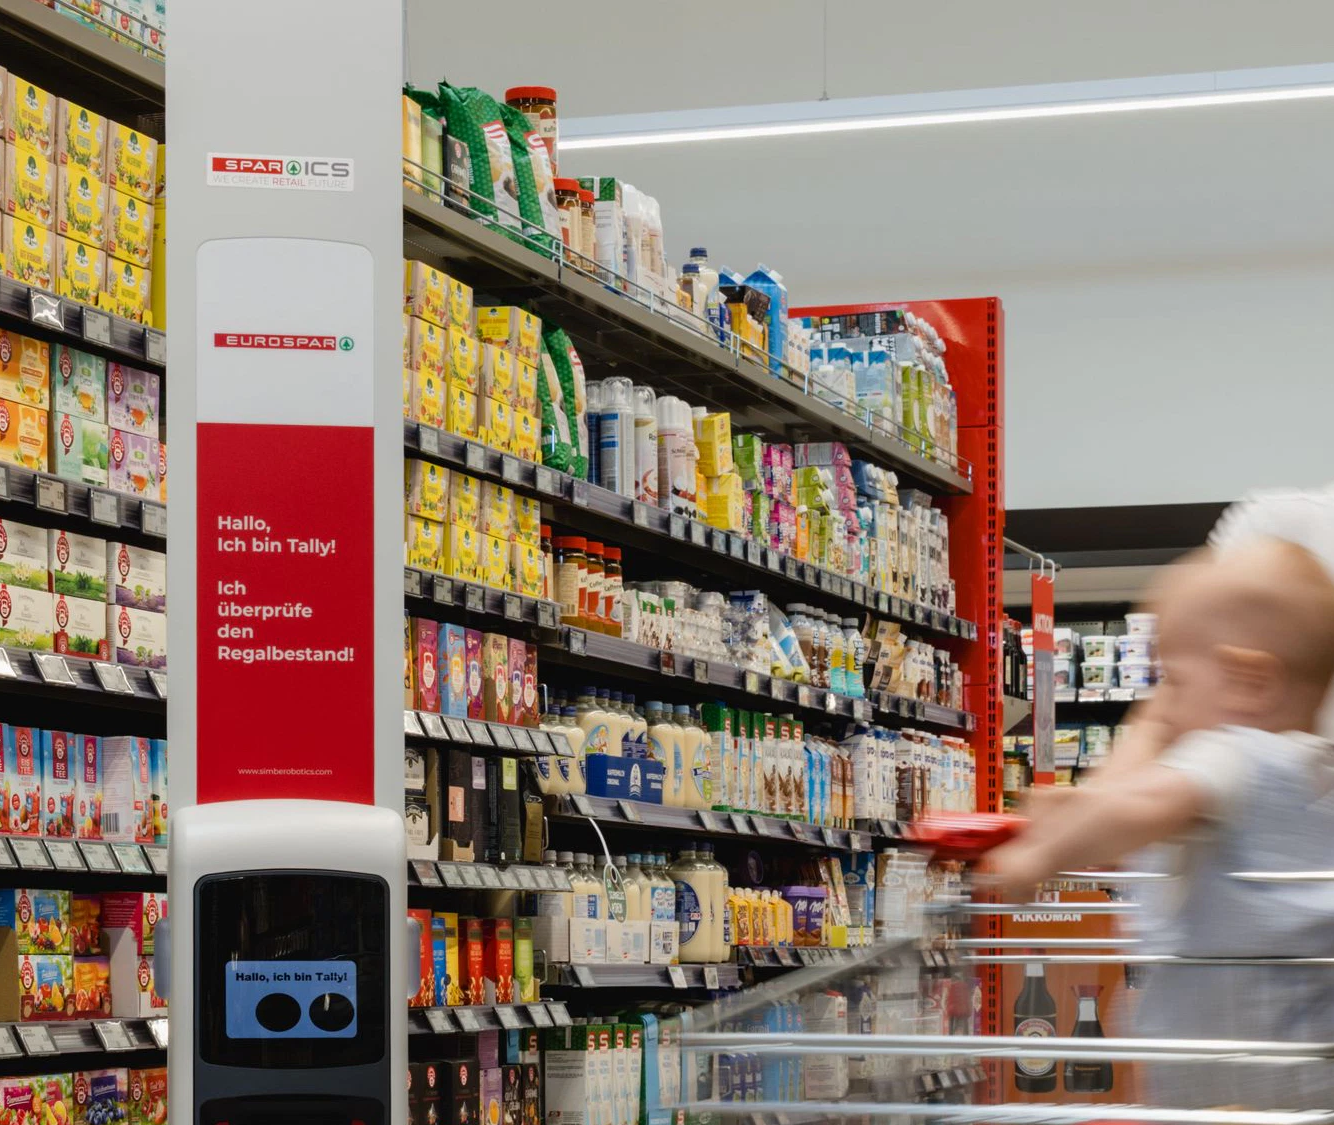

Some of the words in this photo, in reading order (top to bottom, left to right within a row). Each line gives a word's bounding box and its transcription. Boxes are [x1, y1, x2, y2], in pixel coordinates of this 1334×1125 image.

[225, 160, 282, 172] SPAR
[305, 161, 349, 177] ICS
[232, 176, 269, 185] CREATE
[272, 178, 306, 187] RETAIL
[308, 179, 348, 189] FUTURE
[226, 335, 335, 348] EUROSPAR
[218, 516, 271, 534] Hallo,
[218, 537, 246, 552] Ich
[252, 537, 282, 553] bin
[287, 538, 336, 557] Tally!
[218, 581, 246, 595] Ich
[218, 602, 313, 621] überprüfe
[217, 624, 254, 639] den
[218, 645, 354, 664] Regalbestand!
[238, 767, 333, 776] www.simberobotics.com
[235, 972, 269, 983] Hallo,
[273, 972, 291, 982] ich
[294, 972, 312, 982] bin
[316, 972, 348, 983] Tally!
